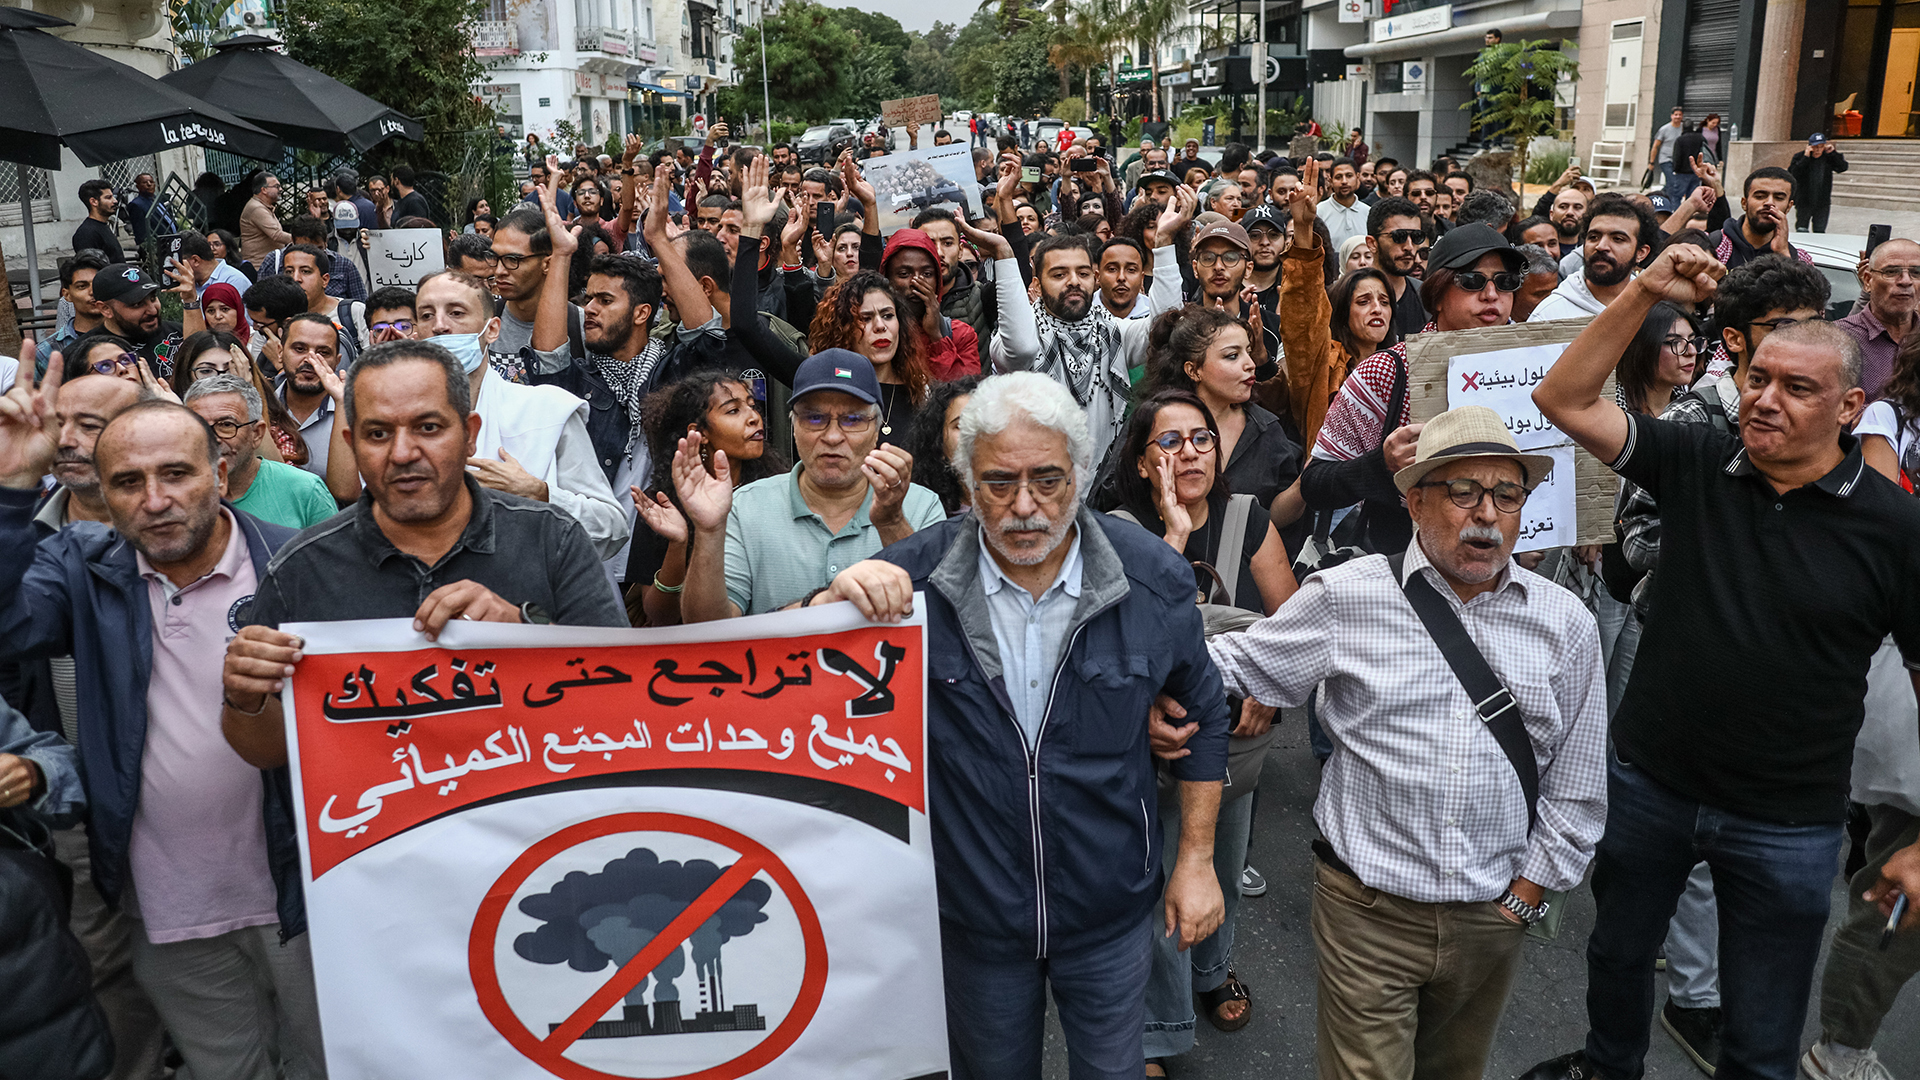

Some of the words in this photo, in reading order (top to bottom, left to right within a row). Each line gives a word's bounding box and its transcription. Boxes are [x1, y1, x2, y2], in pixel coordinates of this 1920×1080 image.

[160, 122, 180, 144] la
[385, 241, 428, 268] كارثة
[1478, 370, 1516, 390] بيئية
[1518, 366, 1549, 386] لول
[1519, 517, 1554, 539] تعزي
[323, 657, 503, 738] تفكيك
[523, 657, 632, 708] حتى
[648, 648, 812, 706] تراجع
[817, 640, 906, 718] لا
[665, 717, 795, 760] وحدات
[808, 714, 912, 783] جميع
